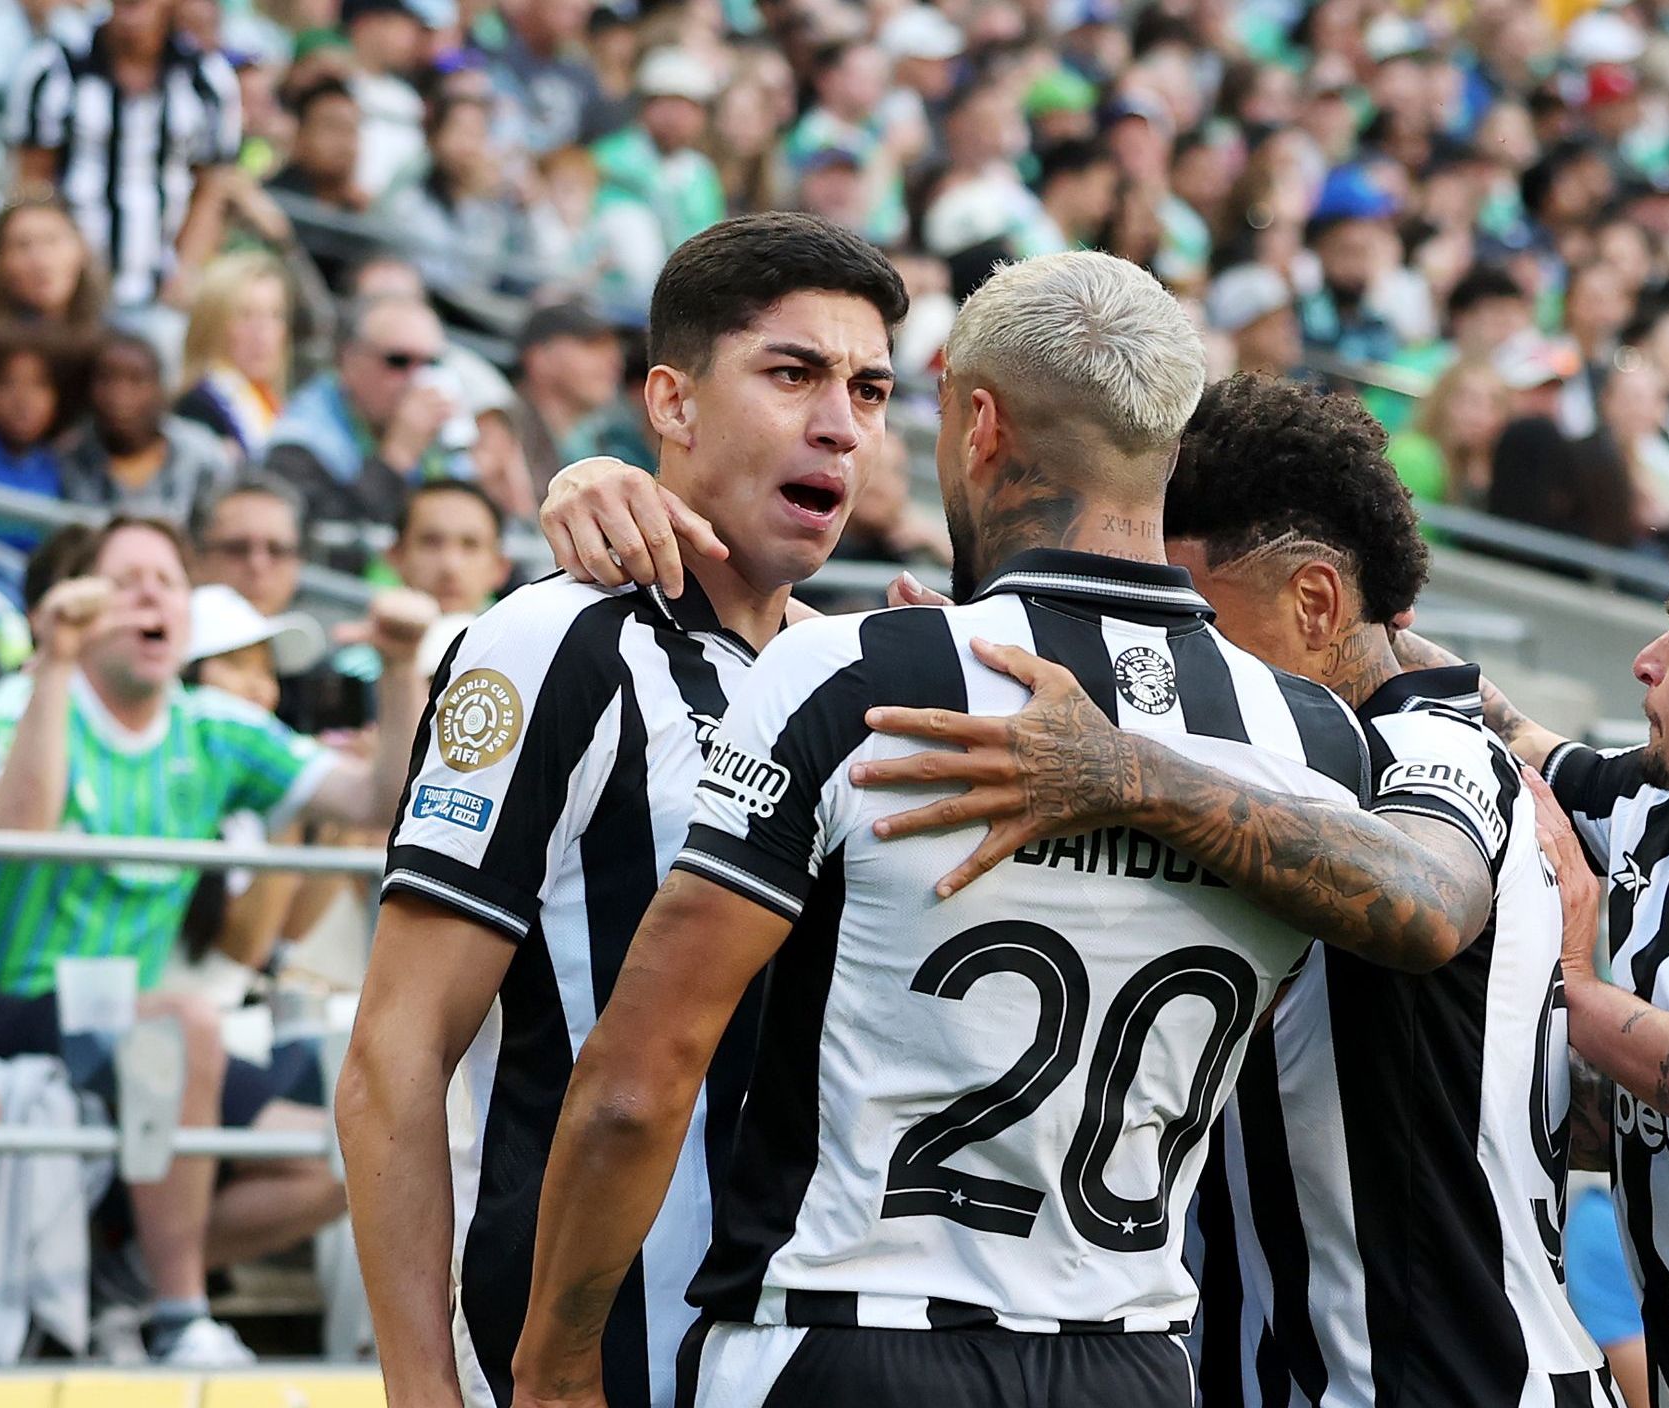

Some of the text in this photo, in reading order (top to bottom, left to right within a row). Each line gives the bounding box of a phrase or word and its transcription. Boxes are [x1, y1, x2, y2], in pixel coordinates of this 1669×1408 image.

[443, 678, 513, 753] CLUB WORLD CUP 25 USA
[448, 745, 481, 765] FIFA
[452, 790, 485, 812] UNITES
[454, 809, 477, 824] FIFA
[880, 919, 1259, 1253] 20
